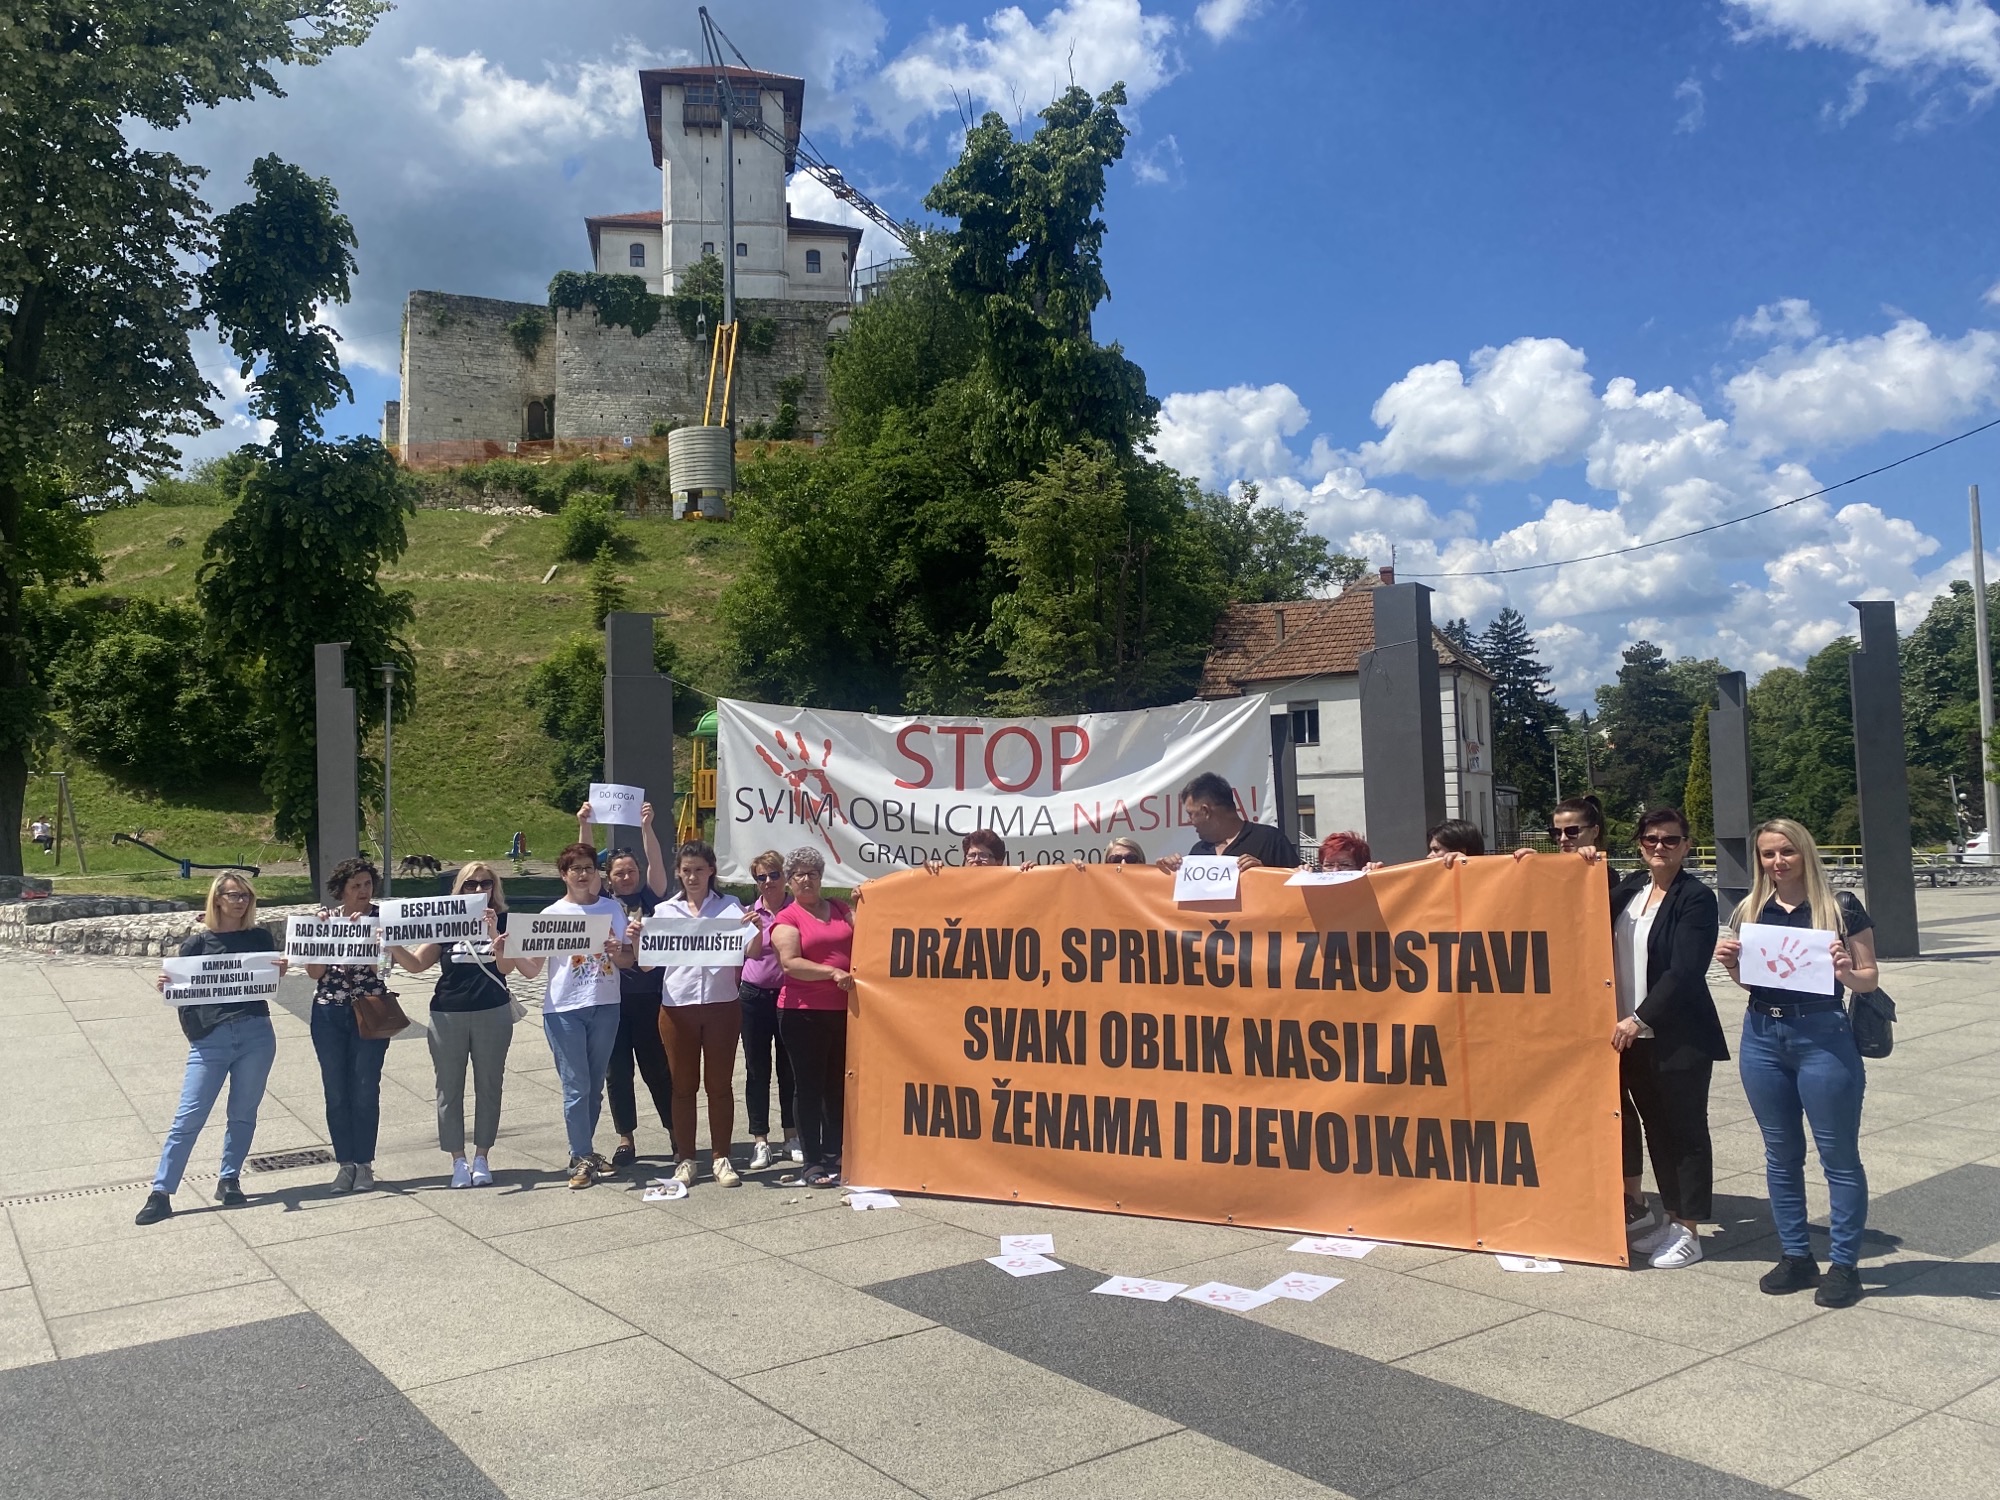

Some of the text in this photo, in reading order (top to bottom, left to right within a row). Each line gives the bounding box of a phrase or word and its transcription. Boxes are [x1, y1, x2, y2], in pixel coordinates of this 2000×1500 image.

[894, 724, 1090, 793] STOP
[599, 791, 635, 801] DO KOGA
[609, 803, 622, 812] JE?
[735, 786, 1259, 838] SVIM OBLICIMA NASILA!
[858, 842, 965, 867] GRADAČ
[1183, 866, 1232, 882] KOGA
[401, 899, 467, 919] BESPLATNA
[295, 923, 372, 938] RAD SA DJECOM
[385, 917, 482, 941] PRAVNA POMOĆ!
[531, 920, 586, 934] SOCIJALNA
[287, 941, 380, 958] I MLADIMA U RIZIKU
[521, 936, 591, 952] KARTA GRADA
[641, 932, 743, 951] SAVJETOVALIŠTE!!
[889, 917, 1552, 995] DRŽAVO, SPRIJEČI I ZAUSTAVI
[202, 960, 243, 971] KAMPANJA
[190, 971, 254, 985] PROTIV NASILJA I
[165, 989, 172, 1000] O
[172, 987, 212, 1000] NAČINIMA
[212, 985, 243, 997] PRIJAVE
[963, 1005, 1447, 1087] SVAKI OBLIK NASILJA
[904, 1077, 1540, 1188] NAD ŽENAMA I DJEVOJKAMA
